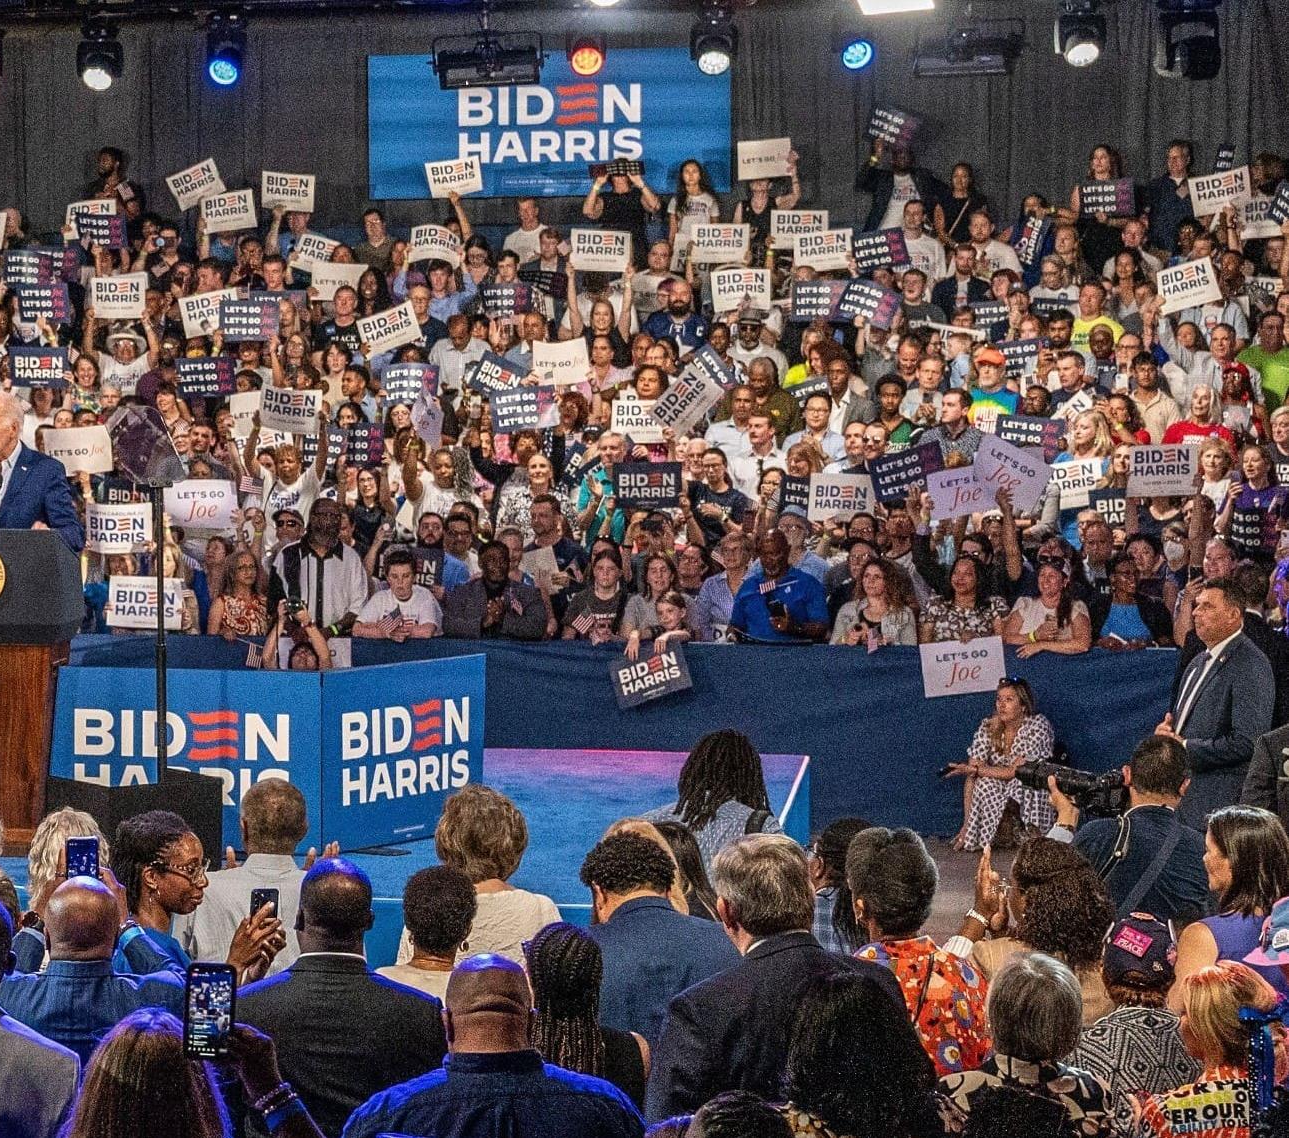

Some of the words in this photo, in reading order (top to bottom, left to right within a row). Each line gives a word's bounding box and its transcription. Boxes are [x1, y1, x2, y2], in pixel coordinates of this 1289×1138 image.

[458, 84, 642, 126] BIDEN
[459, 129, 643, 164] HARRIS
[431, 161, 474, 176] BIDEN
[172, 165, 211, 189] BIDEN
[267, 175, 308, 188] BIDEN
[432, 172, 476, 185] HARRIS
[1195, 171, 1243, 192] BIDEN
[176, 175, 215, 197] HARRIS
[266, 186, 309, 198] HARRIS
[1198, 184, 1245, 201] HARRIS
[205, 195, 247, 210] BIDEN
[205, 204, 248, 219] HARRIS
[777, 214, 822, 226] BIDEN
[415, 229, 457, 243] BIDEN
[577, 234, 625, 246] BIDEN
[697, 228, 742, 238] BIDEN
[696, 239, 743, 248] HARRIS
[800, 234, 846, 248] BIDEN
[855, 238, 874, 247] LET'S
[576, 246, 625, 256] HARRIS
[800, 245, 846, 257] HARRIS
[856, 249, 876, 258] LET'S
[717, 272, 764, 285] BIDEN
[1161, 264, 1206, 286] BIDEN
[96, 282, 139, 293] BIDEN
[718, 284, 764, 295] HARRIS
[1163, 277, 1209, 296] HARRIS
[96, 294, 139, 302] HARRIS
[224, 305, 247, 314] LET'S
[249, 306, 261, 314] GO
[224, 317, 247, 325] LET'S
[249, 317, 261, 325] GO
[363, 307, 409, 333] BIDEN
[224, 327, 247, 335] LET'S
[249, 327, 261, 335] GO
[366, 320, 412, 343] HARRIS
[15, 357, 62, 368] BIDEN
[180, 364, 203, 372] LET'S
[205, 362, 216, 370] GO
[15, 367, 63, 379] HARRIS
[205, 373, 218, 381] GO
[386, 370, 408, 379] LET'S
[409, 370, 422, 378] GO
[481, 361, 521, 388] BIDEN
[183, 385, 205, 393] LET'S
[386, 381, 408, 389] LET'S
[409, 381, 422, 389] GO
[264, 389, 316, 406] BIDEN
[654, 372, 698, 419] BIDEN
[263, 404, 316, 418] HARRIS
[497, 406, 522, 415] LET'S
[665, 382, 705, 427] HARRIS
[499, 418, 523, 427] LET'S
[1001, 432, 1026, 441] LET'S
[1027, 433, 1041, 443] GO
[1134, 448, 1189, 464] BIDEN
[876, 461, 903, 473] LET'S
[904, 454, 919, 464] GO
[991, 449, 1018, 469] LET'S
[1019, 464, 1035, 478] GO
[1134, 464, 1190, 476] HARRIS
[618, 471, 675, 487] BIDEN
[879, 473, 906, 485] LET'S
[908, 467, 922, 476] GO
[940, 477, 970, 488] LET'S
[985, 463, 1022, 491] Joe
[177, 490, 205, 499] LET'S
[209, 490, 224, 498] GO
[618, 485, 675, 499] HARRIS
[815, 484, 867, 499] BIDEN
[949, 486, 983, 511] Joe
[184, 500, 217, 522] Joe
[814, 499, 867, 511] HARRIS
[91, 517, 144, 531] BIDEN
[90, 532, 145, 543] HARRIS
[116, 590, 175, 605] BIDEN
[935, 651, 967, 662] LET'S
[970, 649, 988, 660] GO
[618, 651, 677, 684] BIDEN
[946, 661, 983, 688] Joe
[622, 666, 681, 696] HARRIS
[73, 708, 290, 762] BIDEN
[341, 696, 470, 761] BIDEN
[342, 750, 470, 806] HARRIS
[1202, 1103, 1246, 1119] OUR
